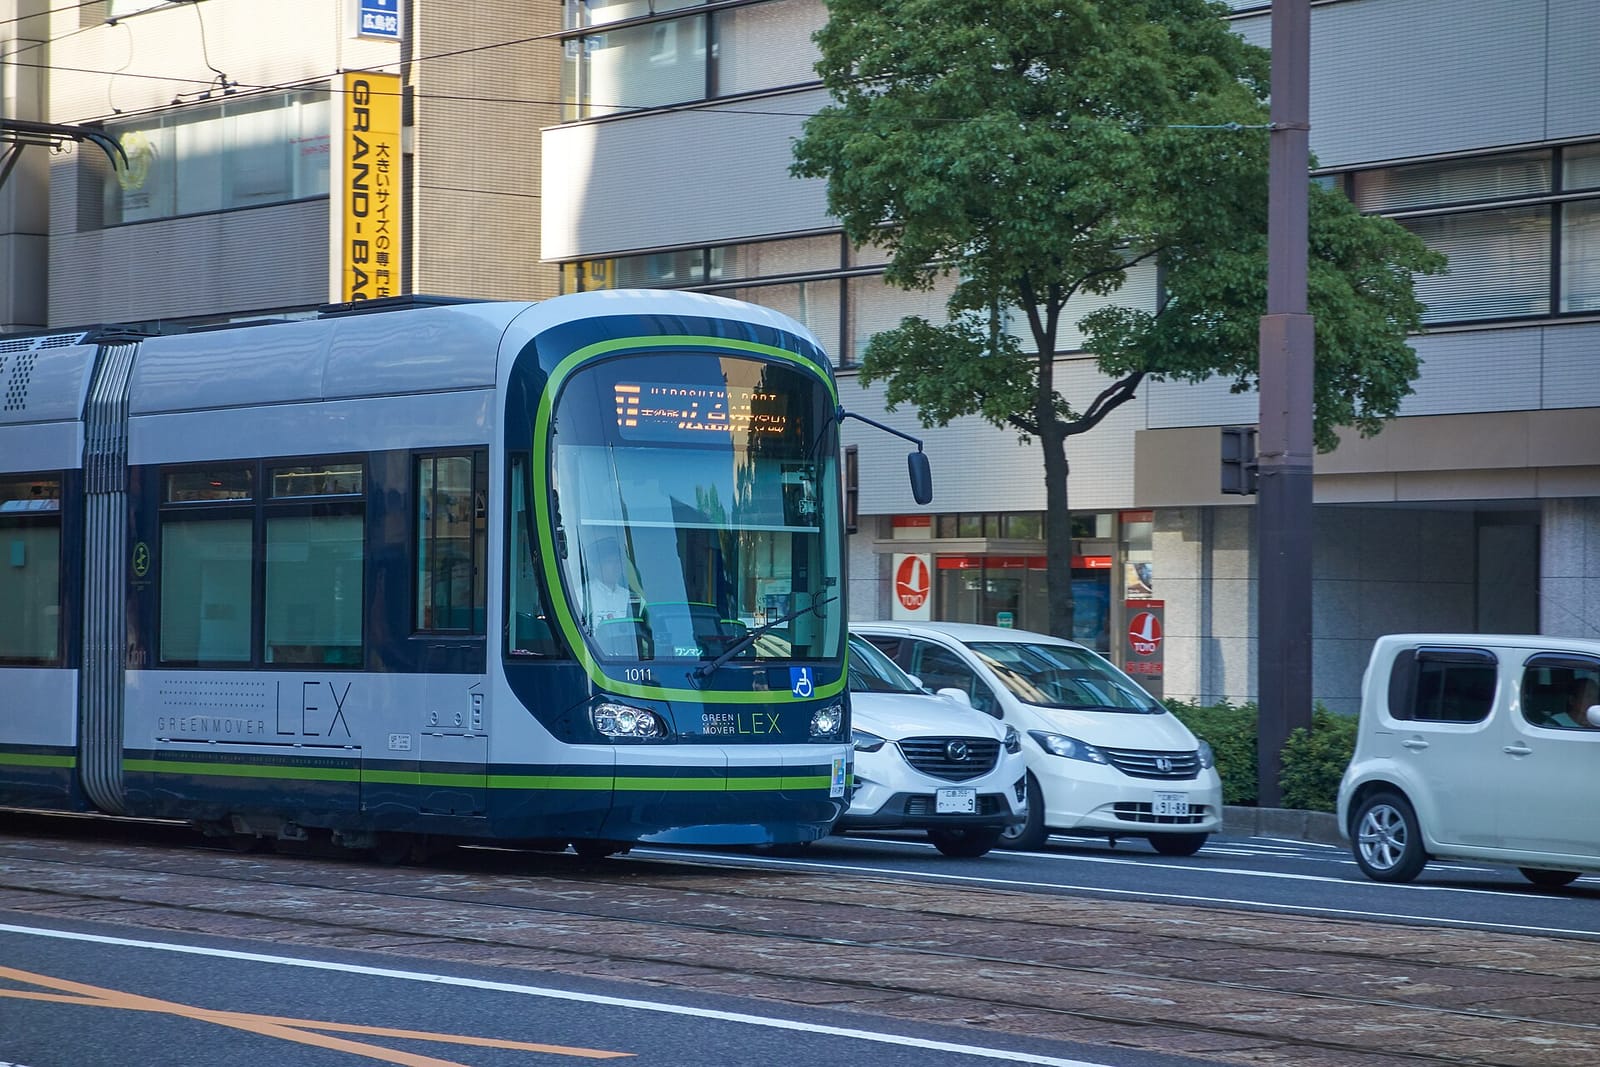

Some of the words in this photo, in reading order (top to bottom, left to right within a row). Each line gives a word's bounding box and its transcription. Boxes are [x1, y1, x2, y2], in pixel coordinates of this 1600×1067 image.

[363, 13, 397, 32] 広島校
[675, 647, 703, 657] ワンマン
[624, 668, 651, 681] 1011
[276, 681, 352, 737] LEX
[701, 713, 734, 722] GREEN
[737, 713, 782, 734] LEX
[702, 726, 736, 735] MOVER
